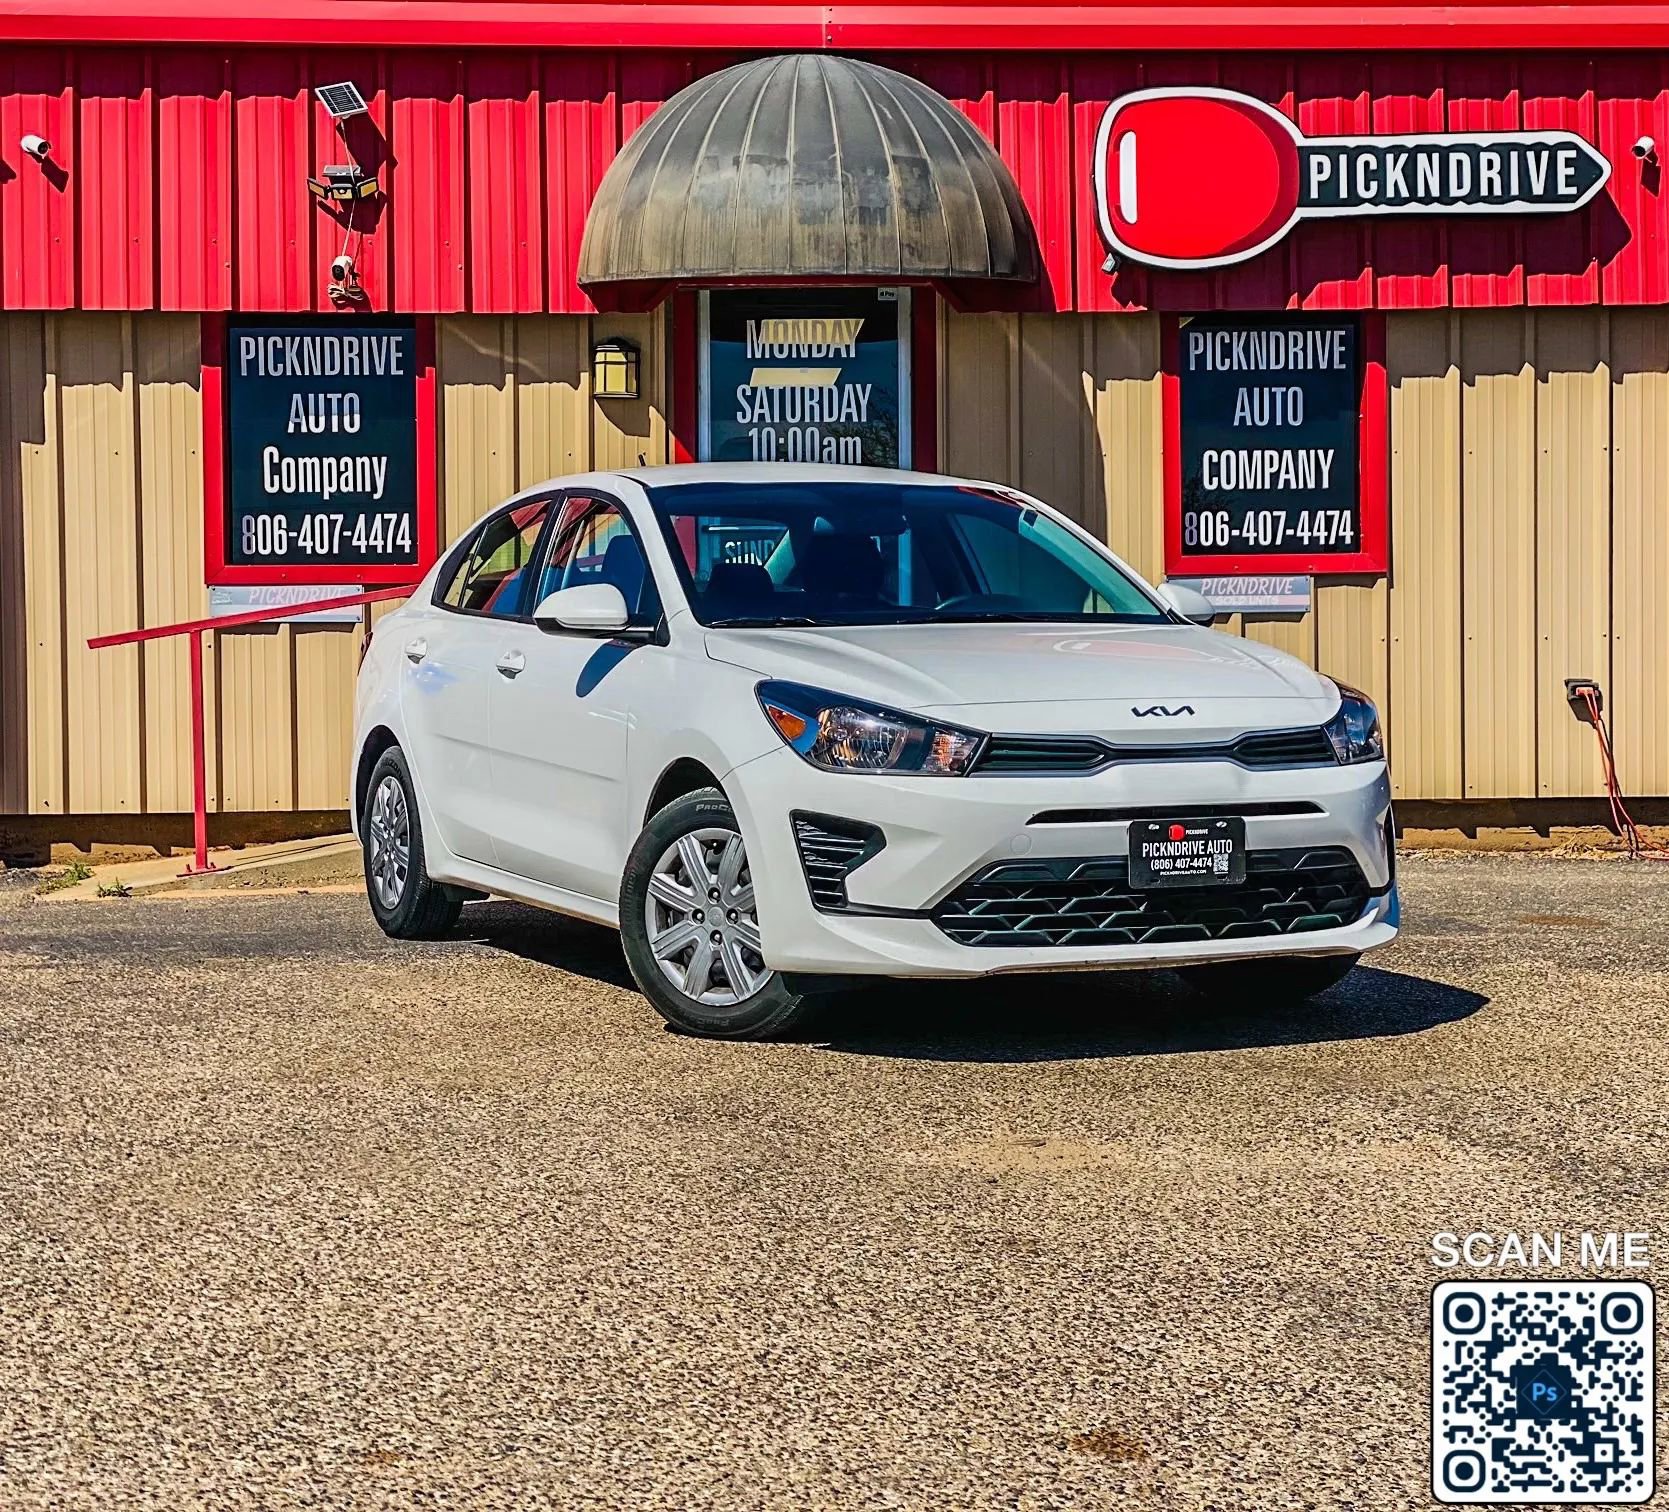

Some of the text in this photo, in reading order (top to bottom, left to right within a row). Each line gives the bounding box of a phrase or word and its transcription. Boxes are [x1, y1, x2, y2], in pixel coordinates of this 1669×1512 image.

[1309, 151, 1578, 199] PICKNDRIVE
[239, 335, 404, 377] PICKNDRIVE
[746, 318, 864, 359] MONDAY
[1189, 330, 1346, 371] PICKNDRIVE
[287, 392, 361, 433] AUTO
[736, 383, 872, 424] SATURDAY
[1233, 386, 1303, 426] AUTO
[748, 426, 862, 464] 10:00am
[263, 446, 387, 500] Company
[1202, 449, 1335, 490] COMPANY
[241, 513, 412, 555] 806-407-4474
[1184, 510, 1354, 546] 806-407-4474
[1201, 577, 1294, 595] PICKNDRIVE
[1142, 839, 1232, 858] PICKNDRIVE AUTO
[1150, 857, 1212, 871] (806) 407-4474
